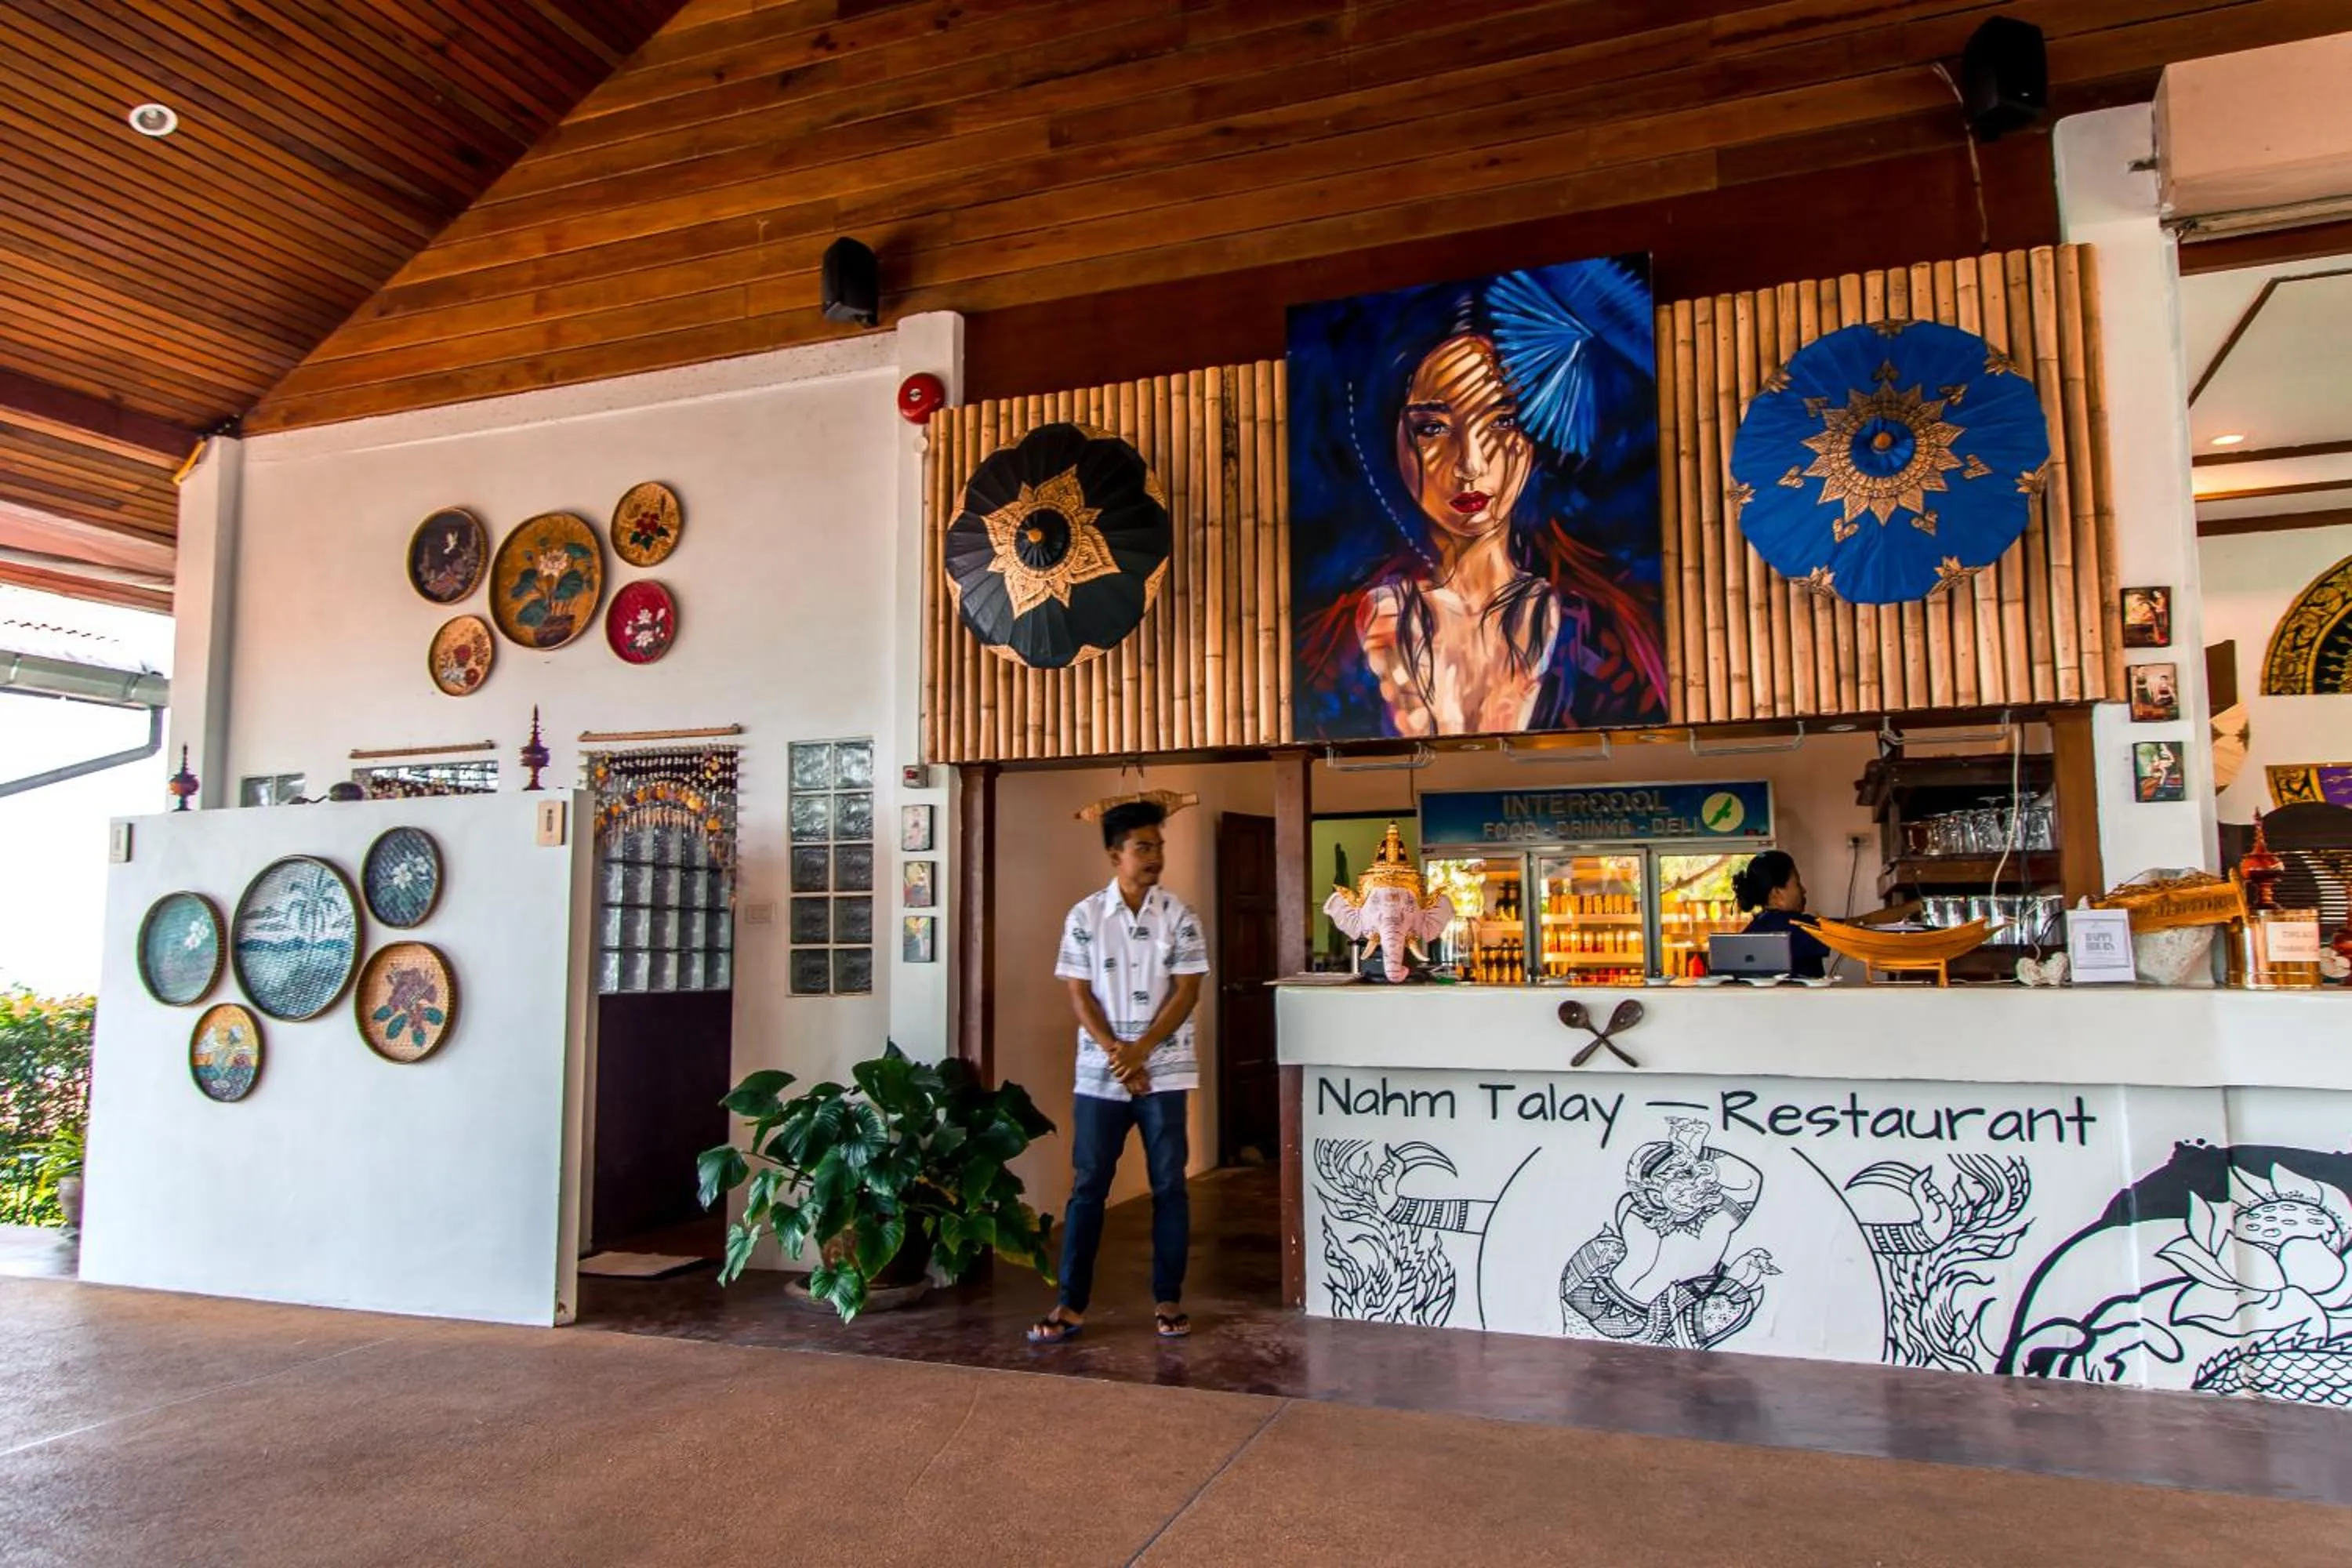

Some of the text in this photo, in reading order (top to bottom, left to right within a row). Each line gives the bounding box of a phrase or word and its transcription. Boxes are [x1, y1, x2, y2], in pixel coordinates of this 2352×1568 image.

[1501, 790, 1671, 818] INTERCOOL
[1482, 821, 1538, 841] FOOD
[1556, 818, 1632, 839] DRINKS
[1650, 816, 1698, 836] DELI
[1317, 1076, 1455, 1119] Nahm
[1478, 1082, 1625, 1149] Talay
[1719, 1090, 2097, 1146] Restaurant
